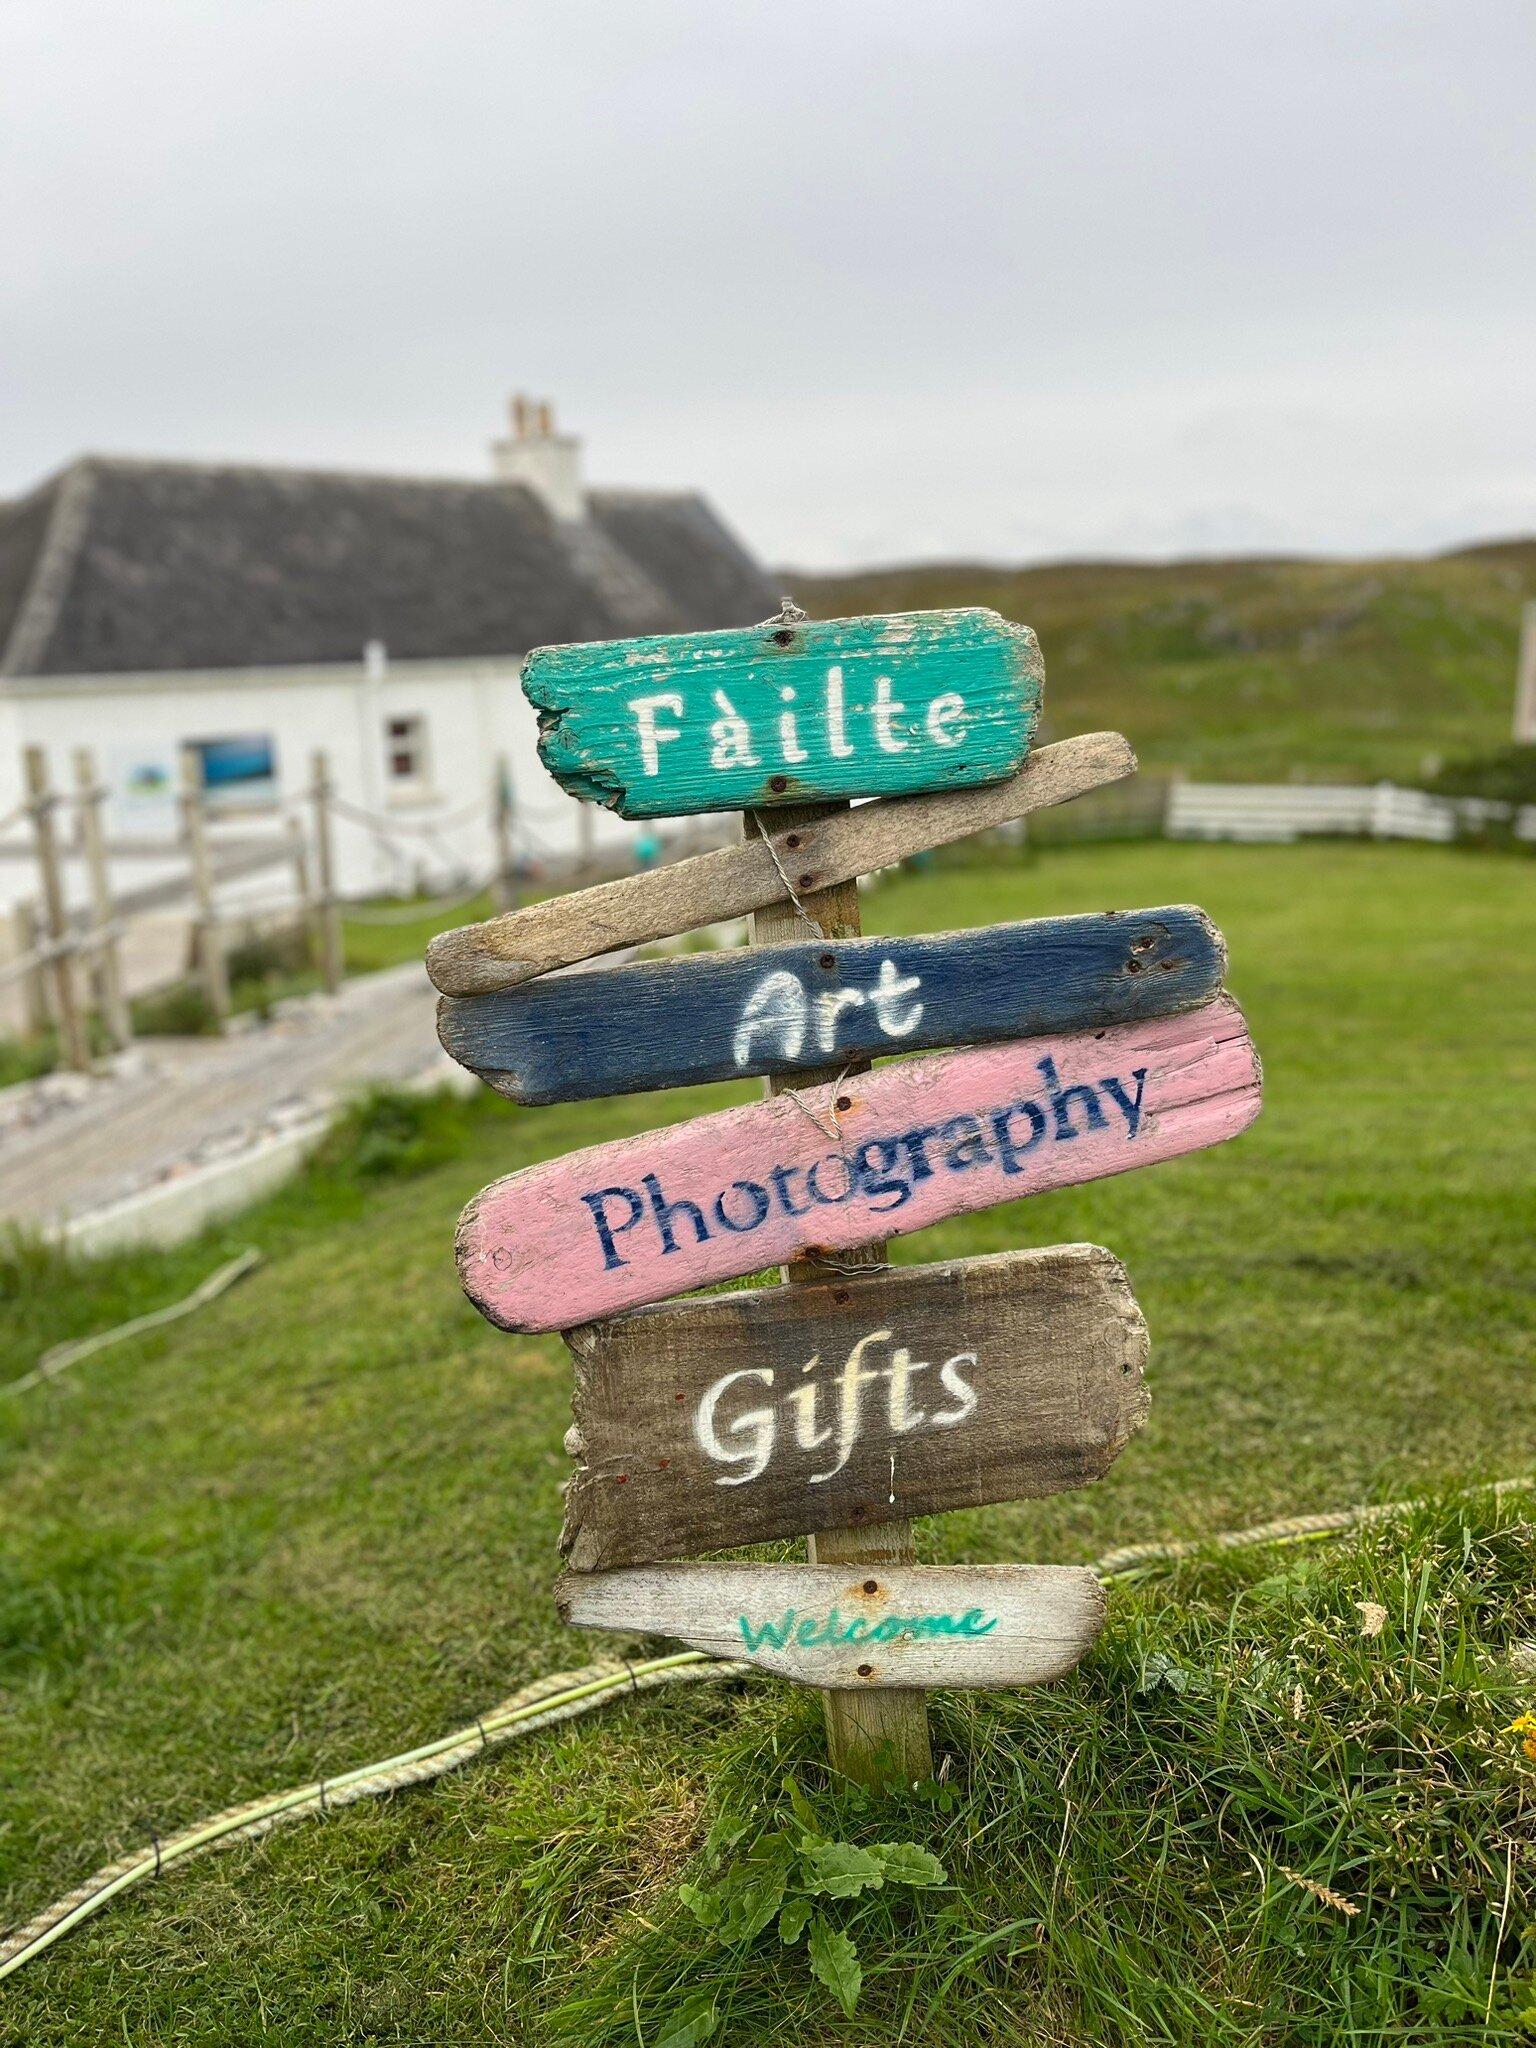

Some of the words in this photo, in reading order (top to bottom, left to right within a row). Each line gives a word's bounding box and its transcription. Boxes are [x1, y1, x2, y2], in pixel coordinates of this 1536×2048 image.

[627, 666, 968, 777] Fàilte
[733, 958, 924, 1068] Art
[580, 1056, 1148, 1271] Photography
[696, 1329, 979, 1486] Gifts
[738, 1606, 998, 1653] Welcome
